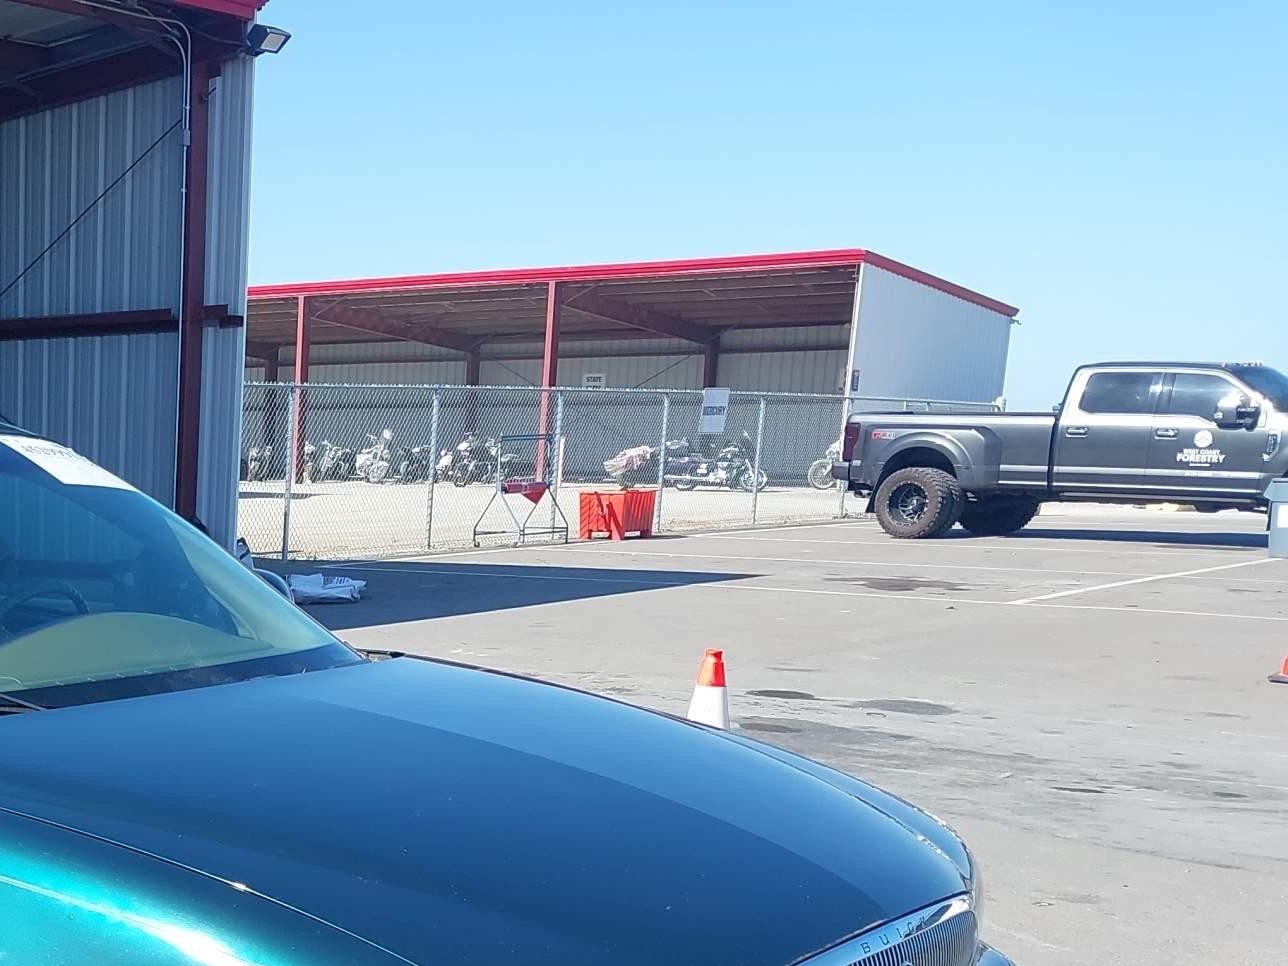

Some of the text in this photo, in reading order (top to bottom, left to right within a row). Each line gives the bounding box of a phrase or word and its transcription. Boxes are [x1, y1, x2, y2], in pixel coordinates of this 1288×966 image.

[586, 375, 603, 383] STATE
[1176, 453, 1226, 464] FORESTRY
[859, 916, 926, 954] BUICK
